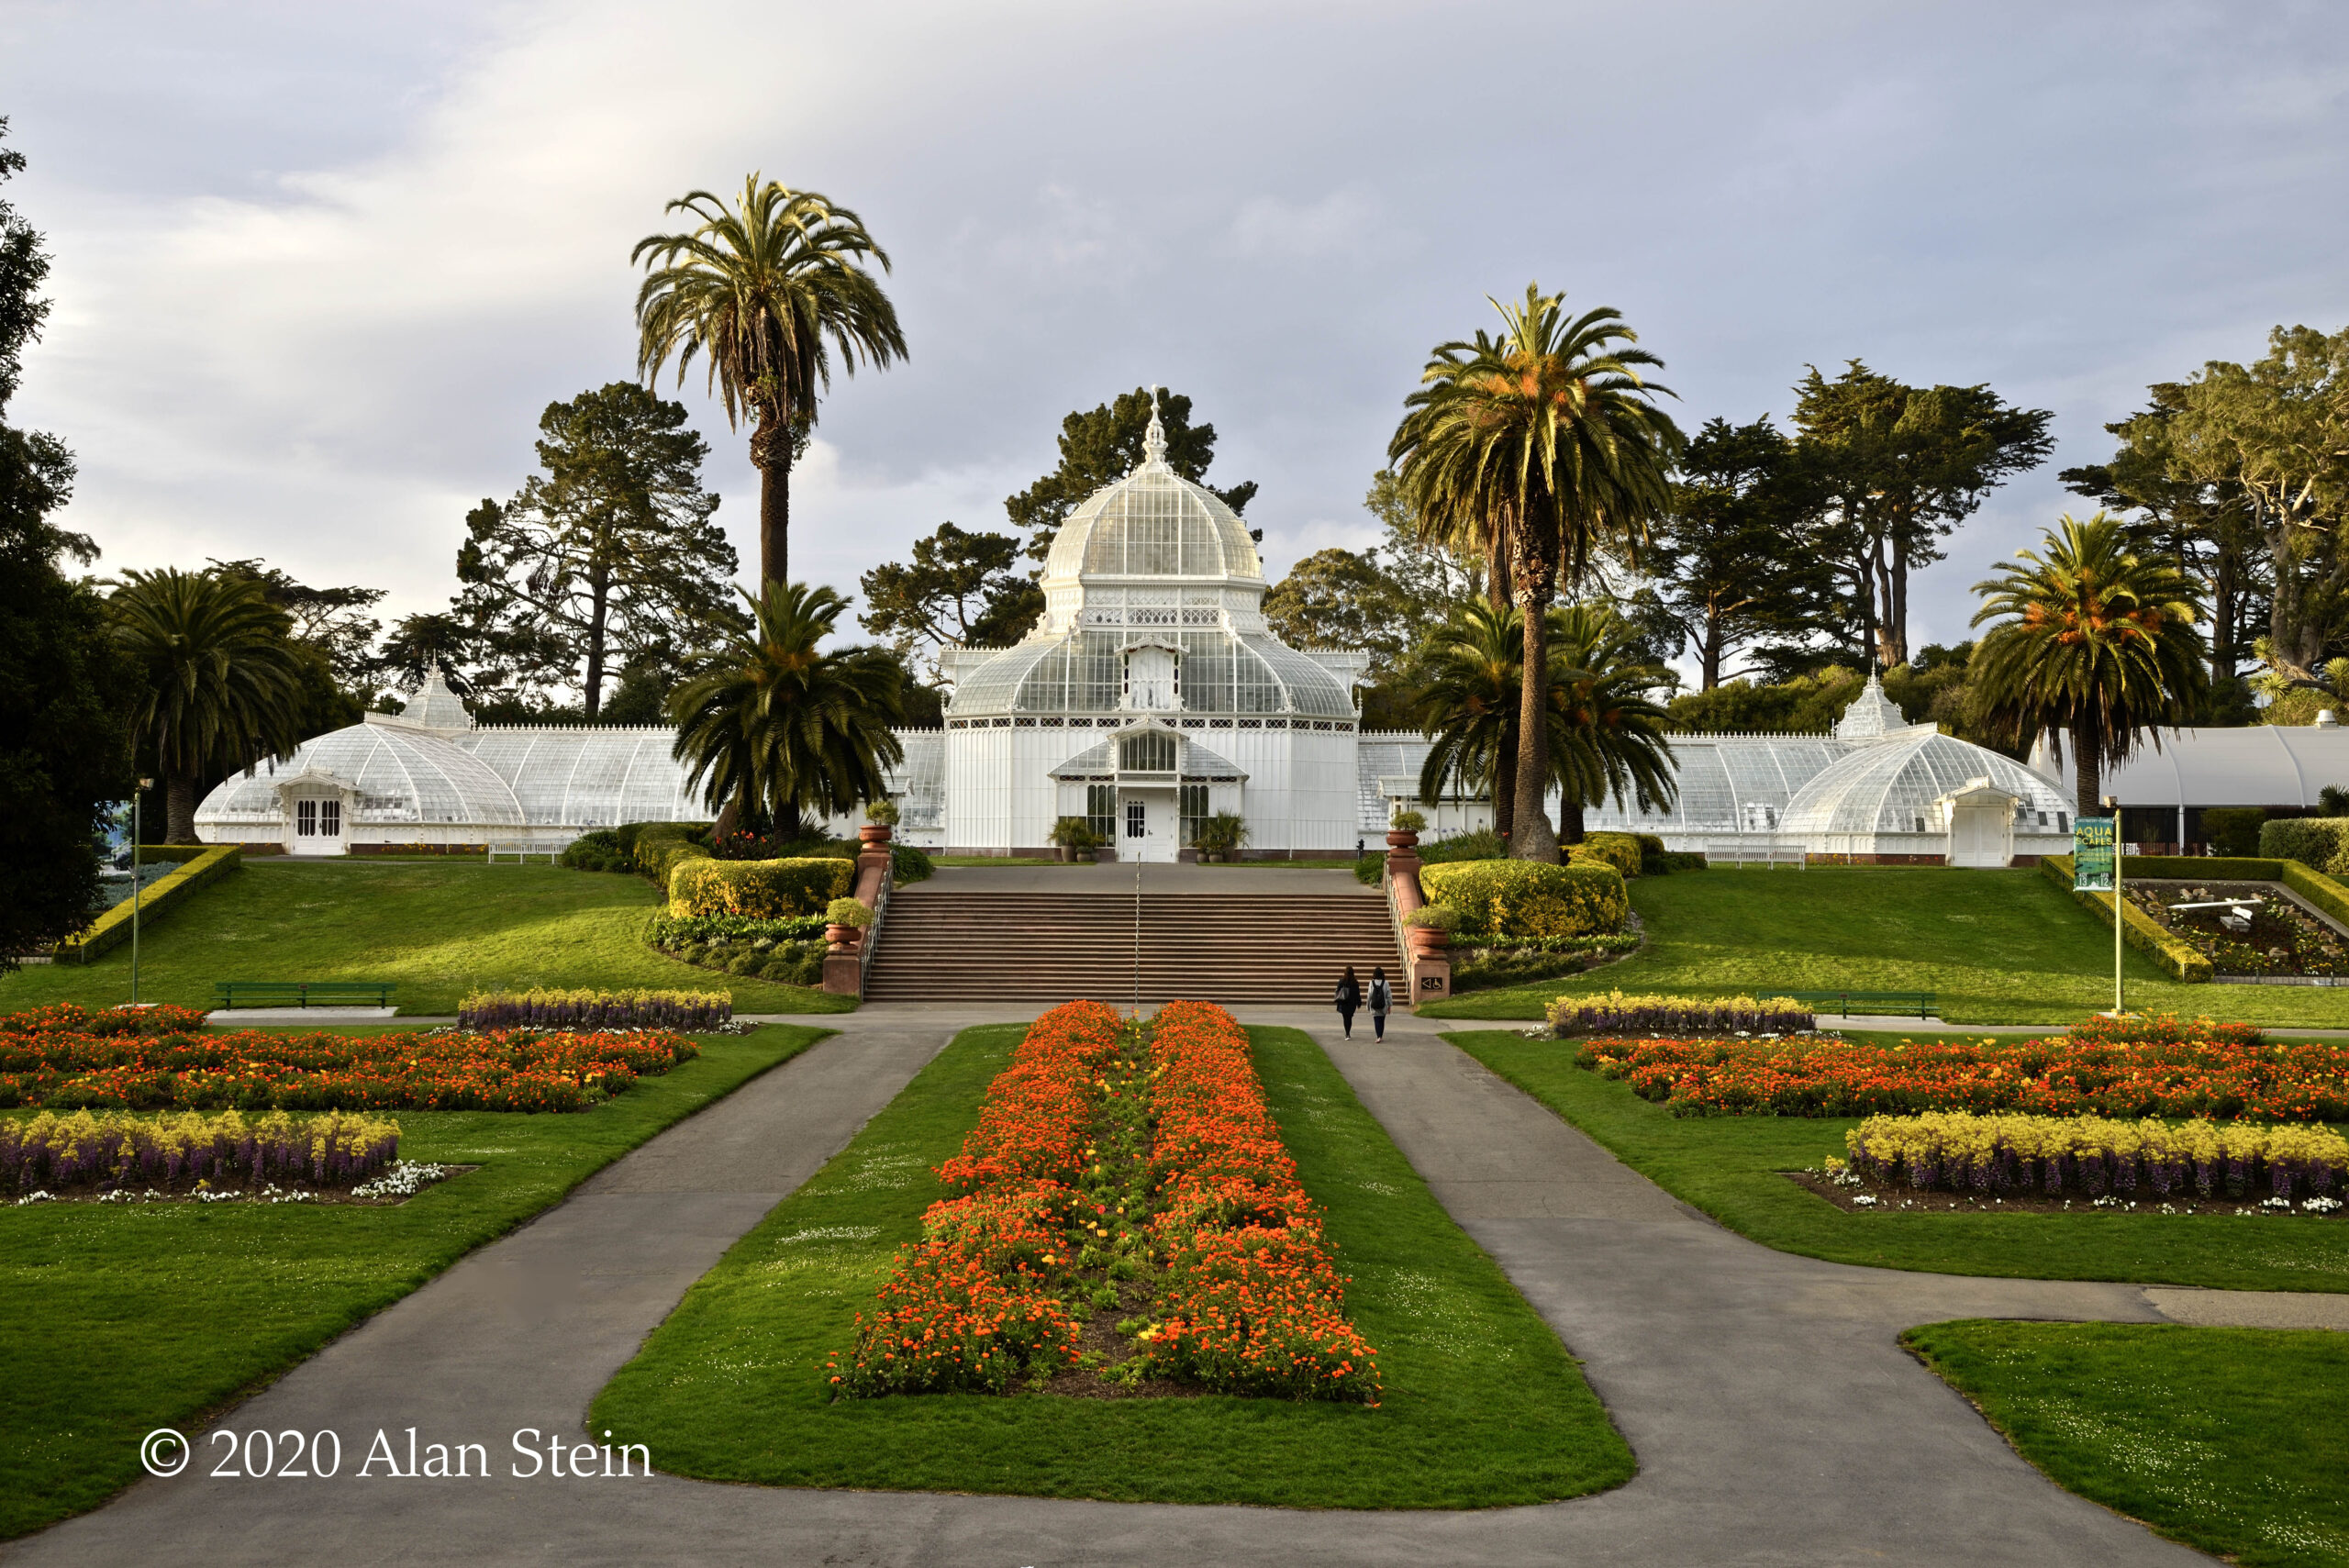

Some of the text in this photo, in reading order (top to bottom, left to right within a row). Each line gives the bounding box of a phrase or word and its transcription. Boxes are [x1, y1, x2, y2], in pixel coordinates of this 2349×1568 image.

[2076, 826, 2112, 837] AQUA
[2075, 837, 2113, 846] SCAPES
[2079, 877, 2109, 886] 13 12
